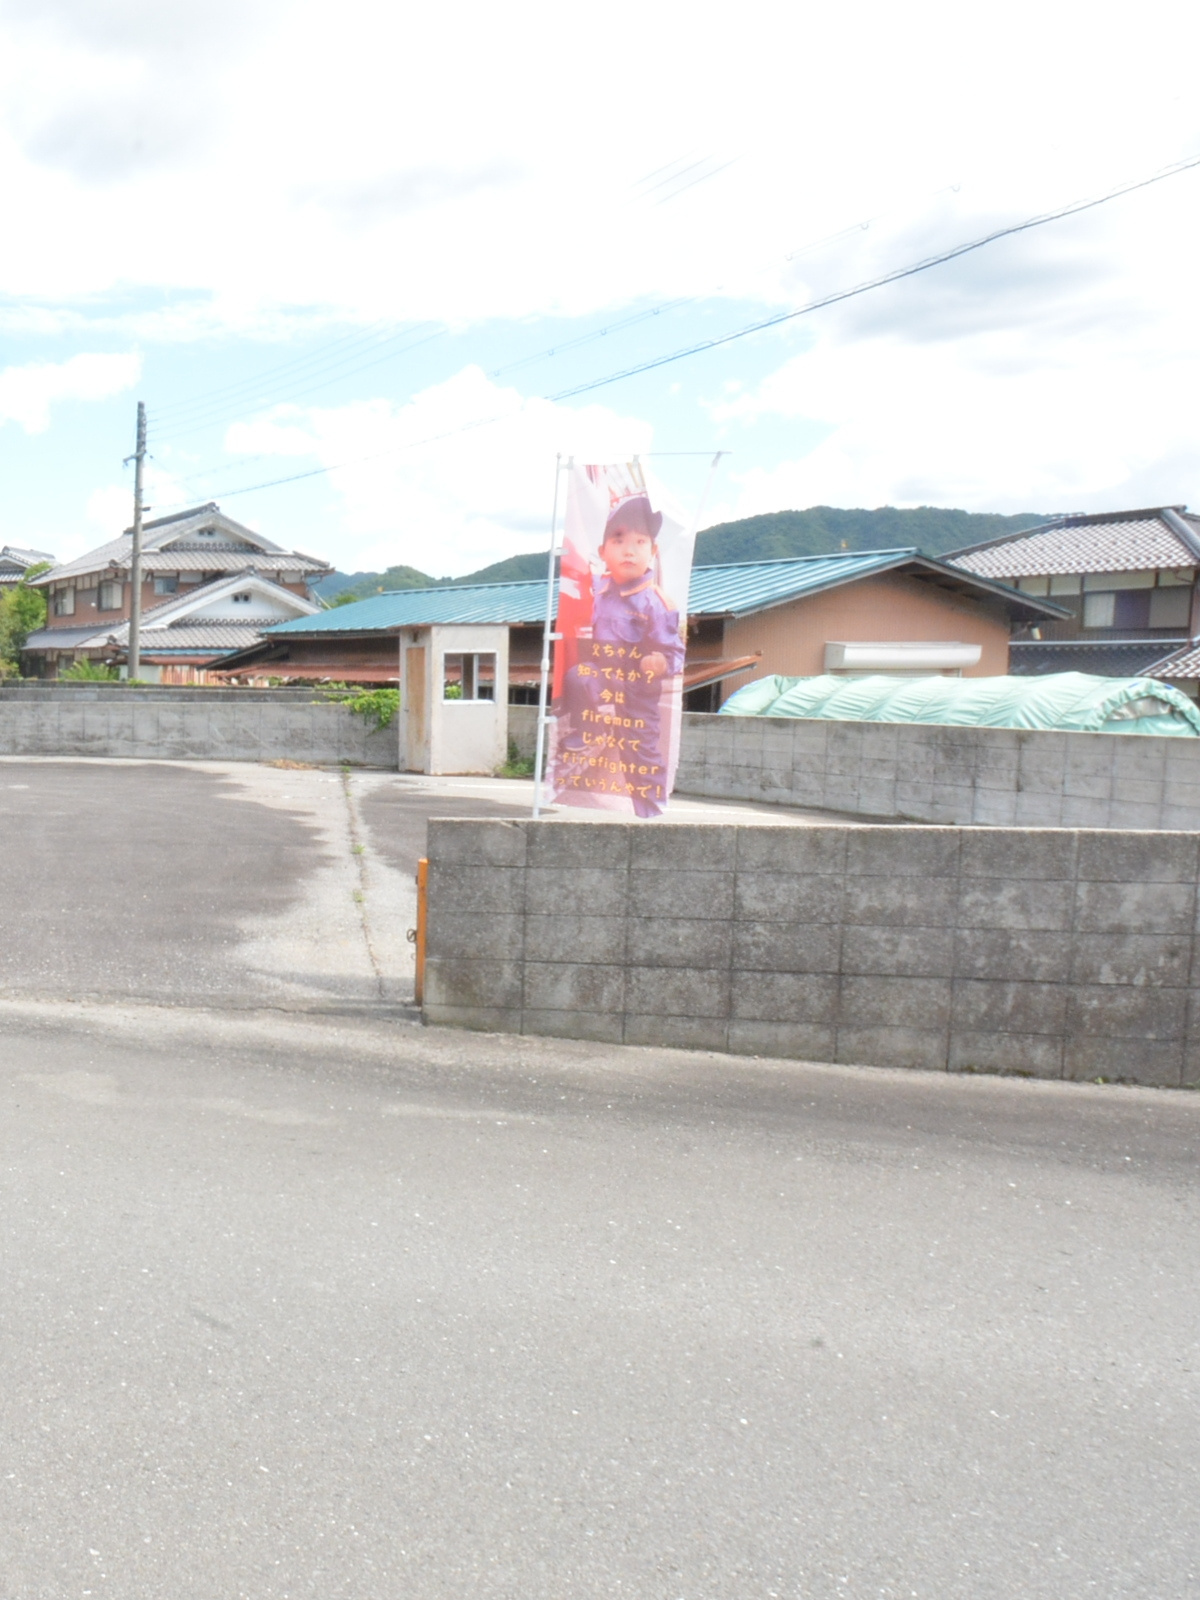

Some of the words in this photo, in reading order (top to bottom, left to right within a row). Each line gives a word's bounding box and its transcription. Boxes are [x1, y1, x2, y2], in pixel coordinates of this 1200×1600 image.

[600, 689, 625, 704] 今は
[582, 710, 645, 728] fireman
[582, 731, 640, 751] じゃなくて
[562, 752, 659, 775] firefighter
